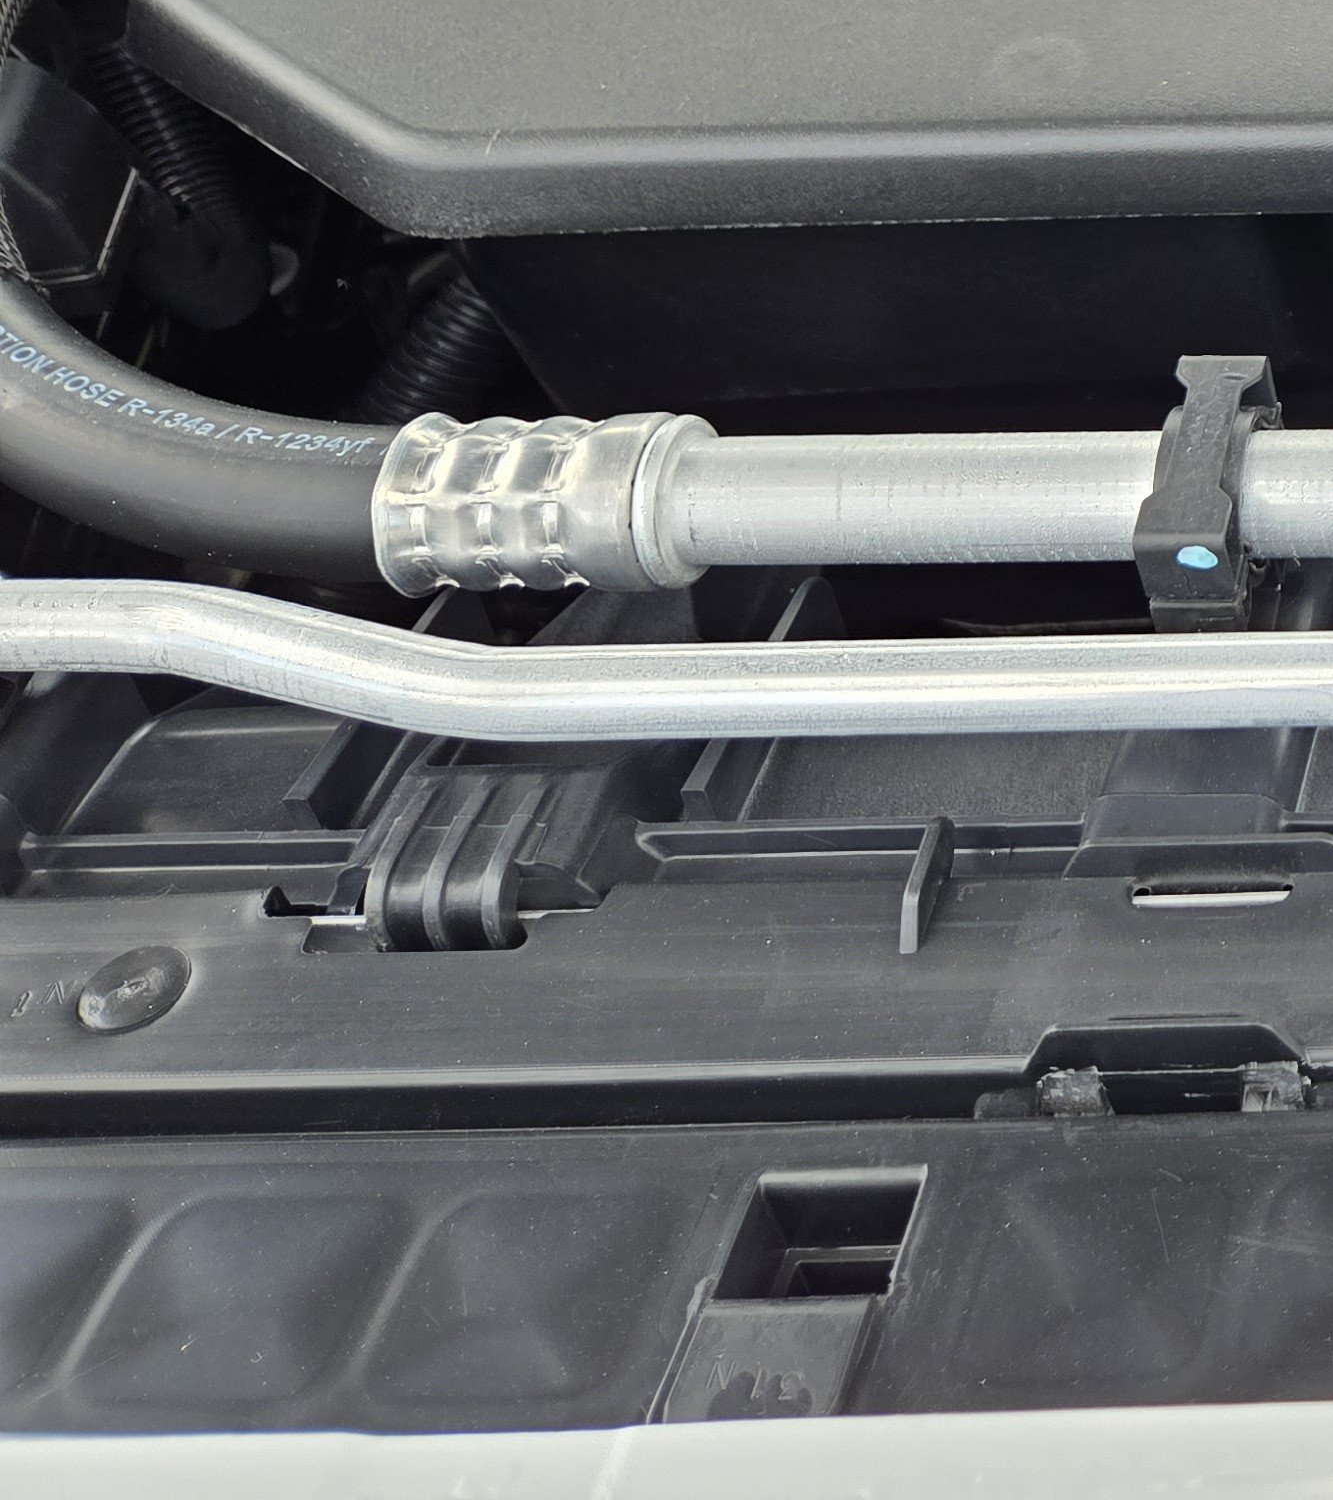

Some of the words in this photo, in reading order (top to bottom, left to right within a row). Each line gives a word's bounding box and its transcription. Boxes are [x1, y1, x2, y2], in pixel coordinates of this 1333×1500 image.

[0, 324, 55, 374] TION
[43, 365, 126, 408] HOSE
[117, 397, 216, 438] R-134a
[234, 425, 377, 458] R-1234yf
